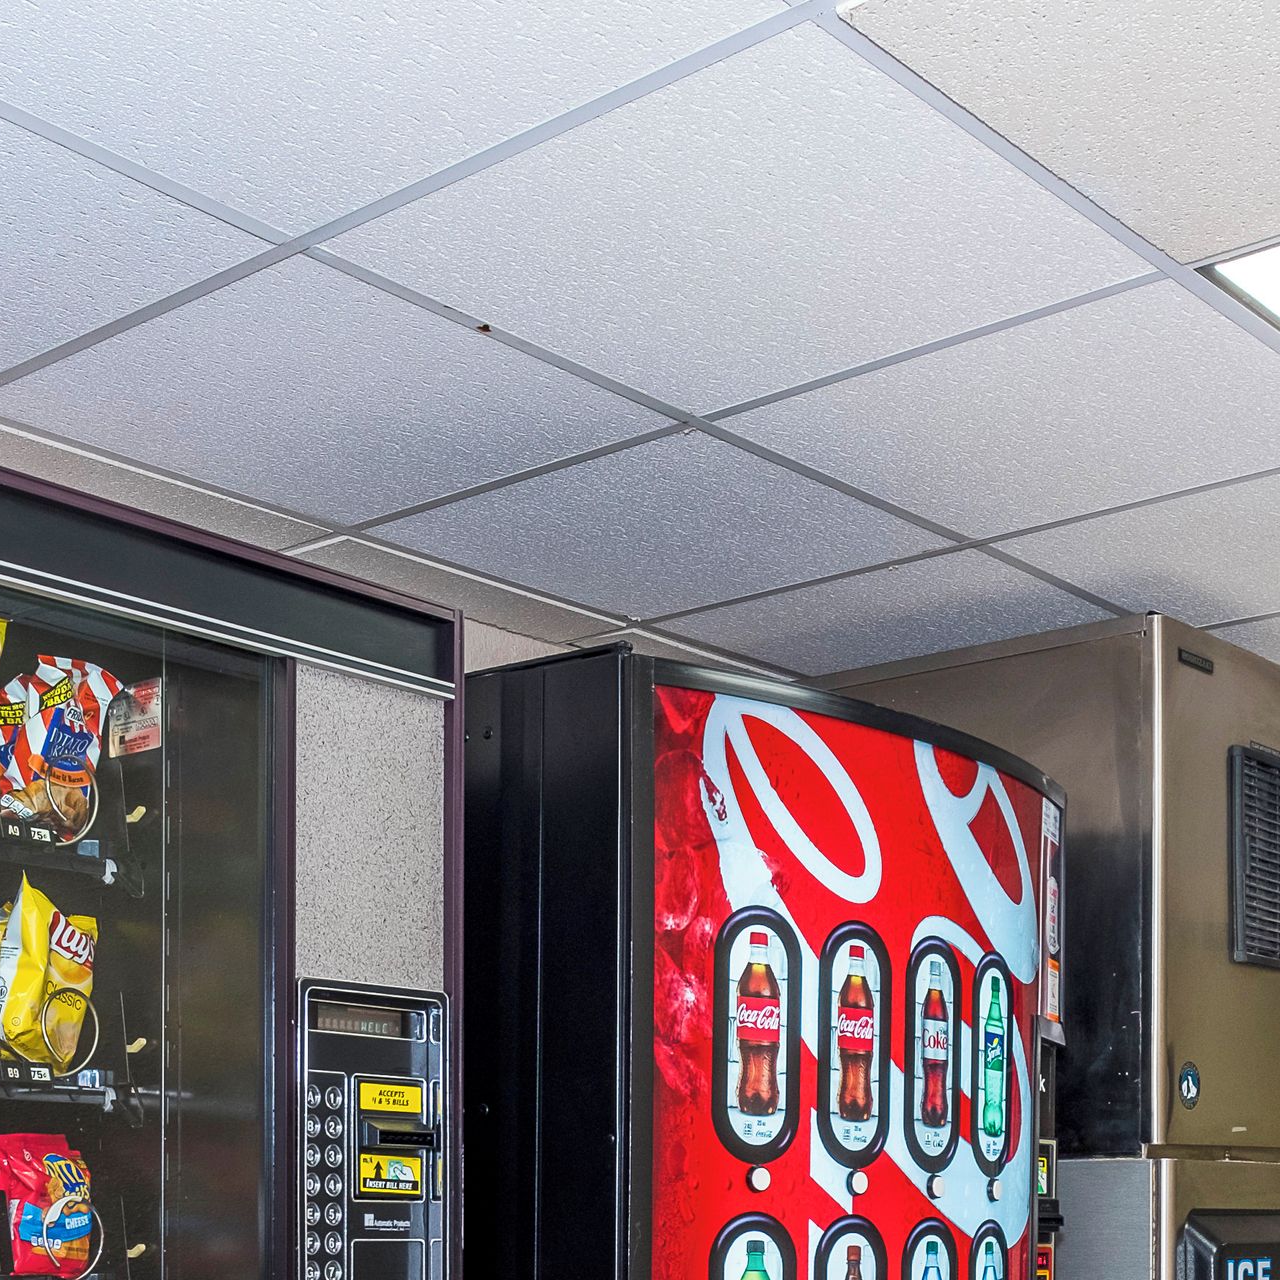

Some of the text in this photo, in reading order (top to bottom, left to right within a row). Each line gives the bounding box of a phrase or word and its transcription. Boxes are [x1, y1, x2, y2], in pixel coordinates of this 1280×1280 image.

[7, 824, 20, 837] A9
[49, 910, 95, 966] Lay's
[736, 1003, 780, 1032] Coca-Cola
[837, 1013, 874, 1041] Coca-Cola
[922, 1028, 948, 1051] Coke
[7, 1066, 20, 1079] B9
[378, 1089, 405, 1099] ACCEPTS
[391, 1098, 410, 1107] BILLS
[365, 1178, 413, 1190] INSERT BILL HERE
[64, 1215, 90, 1230] CHEESE
